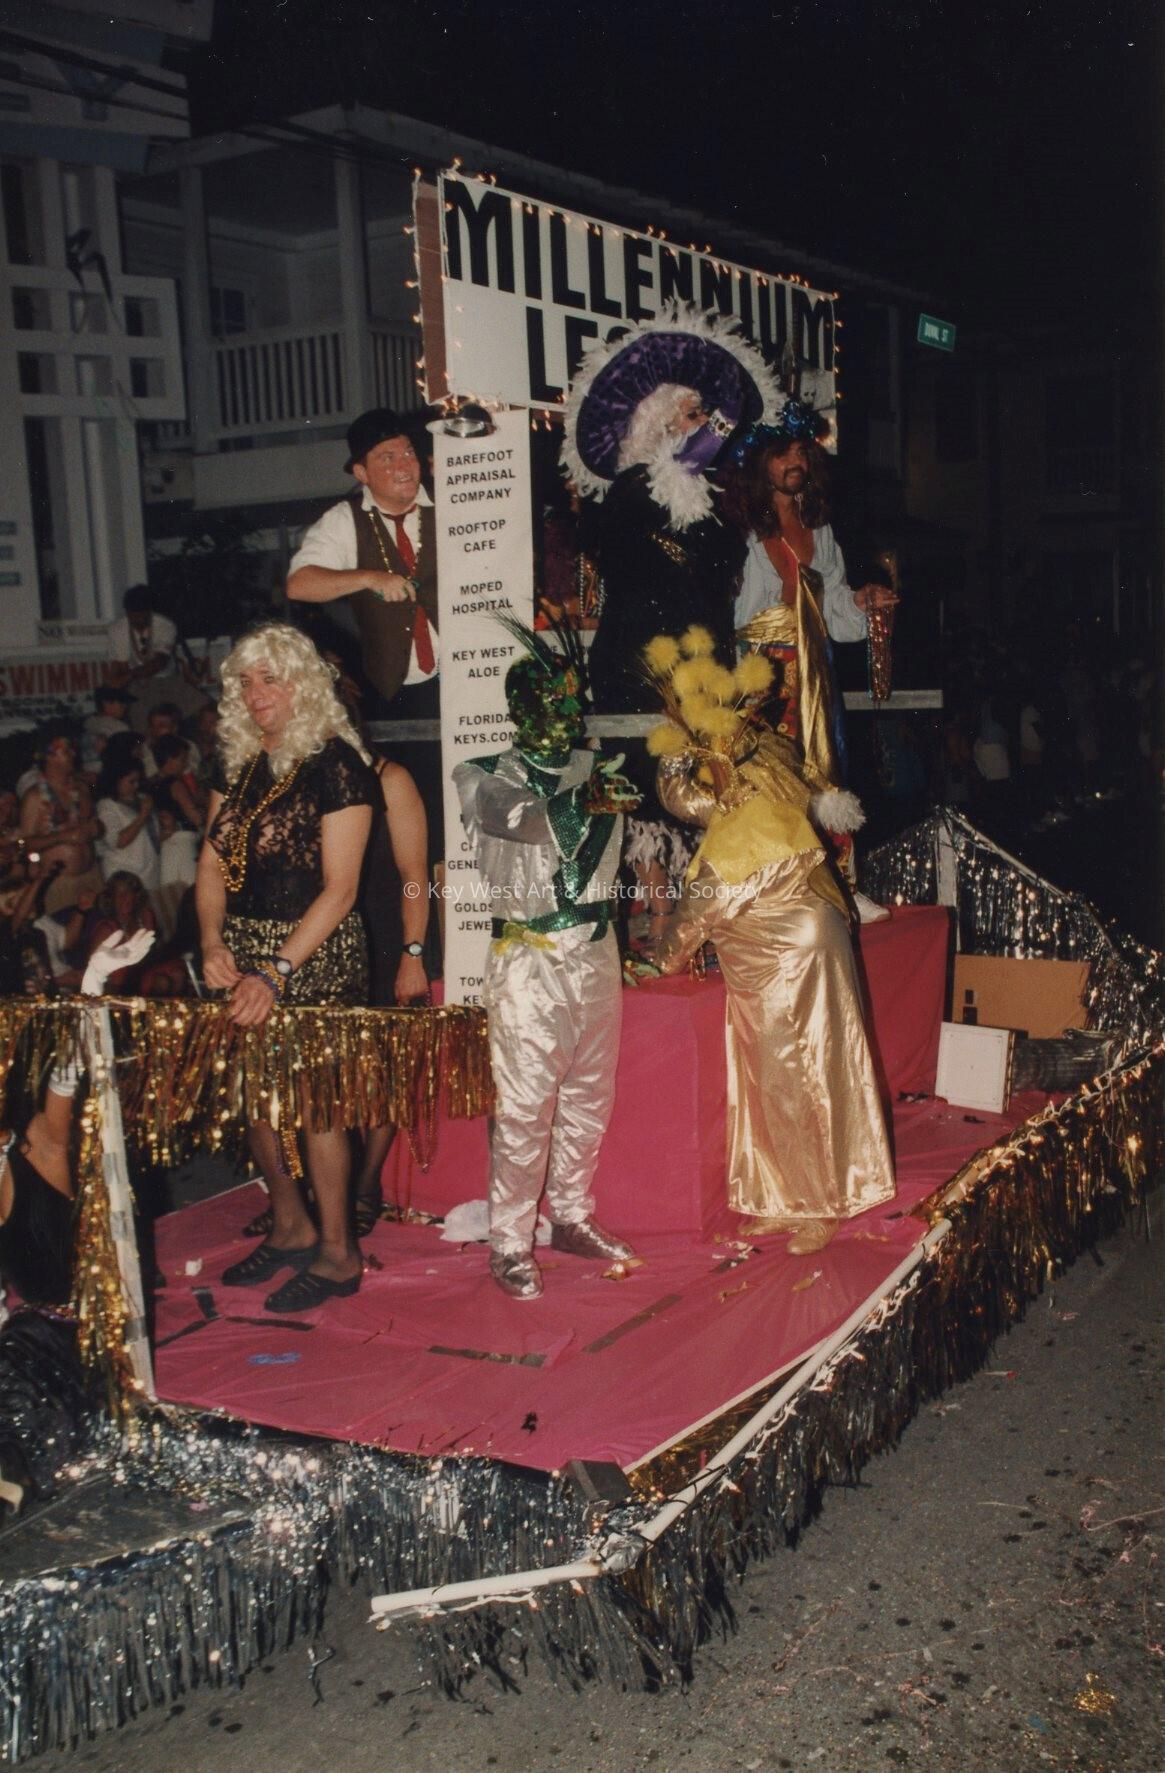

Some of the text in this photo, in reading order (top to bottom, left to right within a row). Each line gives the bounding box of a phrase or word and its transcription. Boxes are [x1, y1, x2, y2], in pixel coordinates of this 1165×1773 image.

[444, 179, 832, 371] MILLENNIUM
[446, 450, 514, 467] BAREFOOT
[446, 469, 516, 486] APPRAISAL
[450, 488, 512, 504] COMPANY
[448, 519, 506, 537] ROOFTOP
[463, 540, 497, 553] CAFE
[460, 581, 503, 595] MOPED
[452, 598, 514, 615] HOSPITAL
[452, 646, 515, 662] KEY WEST
[468, 666, 500, 679] ALOE
[459, 713, 511, 726] FLORIDA
